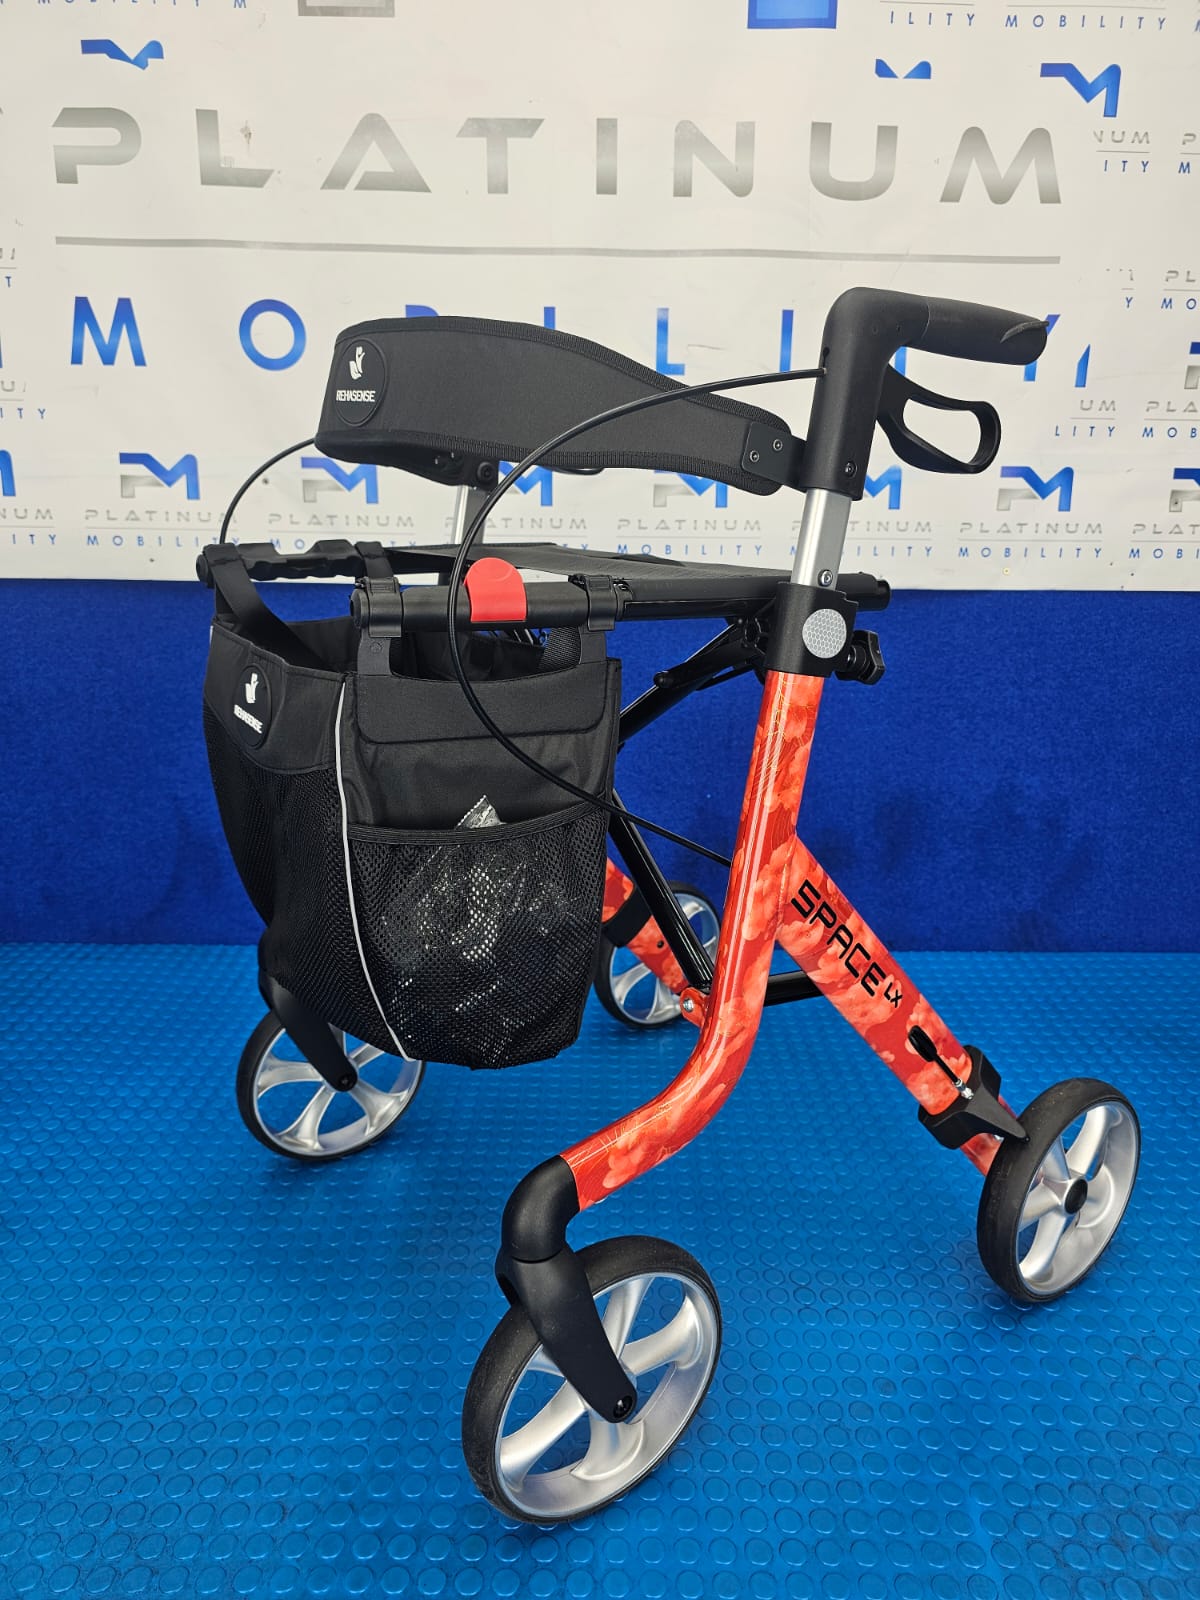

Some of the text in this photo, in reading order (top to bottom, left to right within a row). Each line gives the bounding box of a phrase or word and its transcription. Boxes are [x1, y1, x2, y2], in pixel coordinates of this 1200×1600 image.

[1005, 14, 1166, 30] MOBILITY
[52, 107, 1061, 205] PLATINUM
[336, 390, 376, 402] REHASENSE
[268, 514, 414, 527] PLATINUM
[617, 519, 761, 531] PLATINUM
[960, 522, 1103, 534] PLATINUM
[618, 543, 762, 556] MOBILITY
[958, 546, 1101, 558] MOBILITY
[791, 879, 903, 1008] SPACE LX
